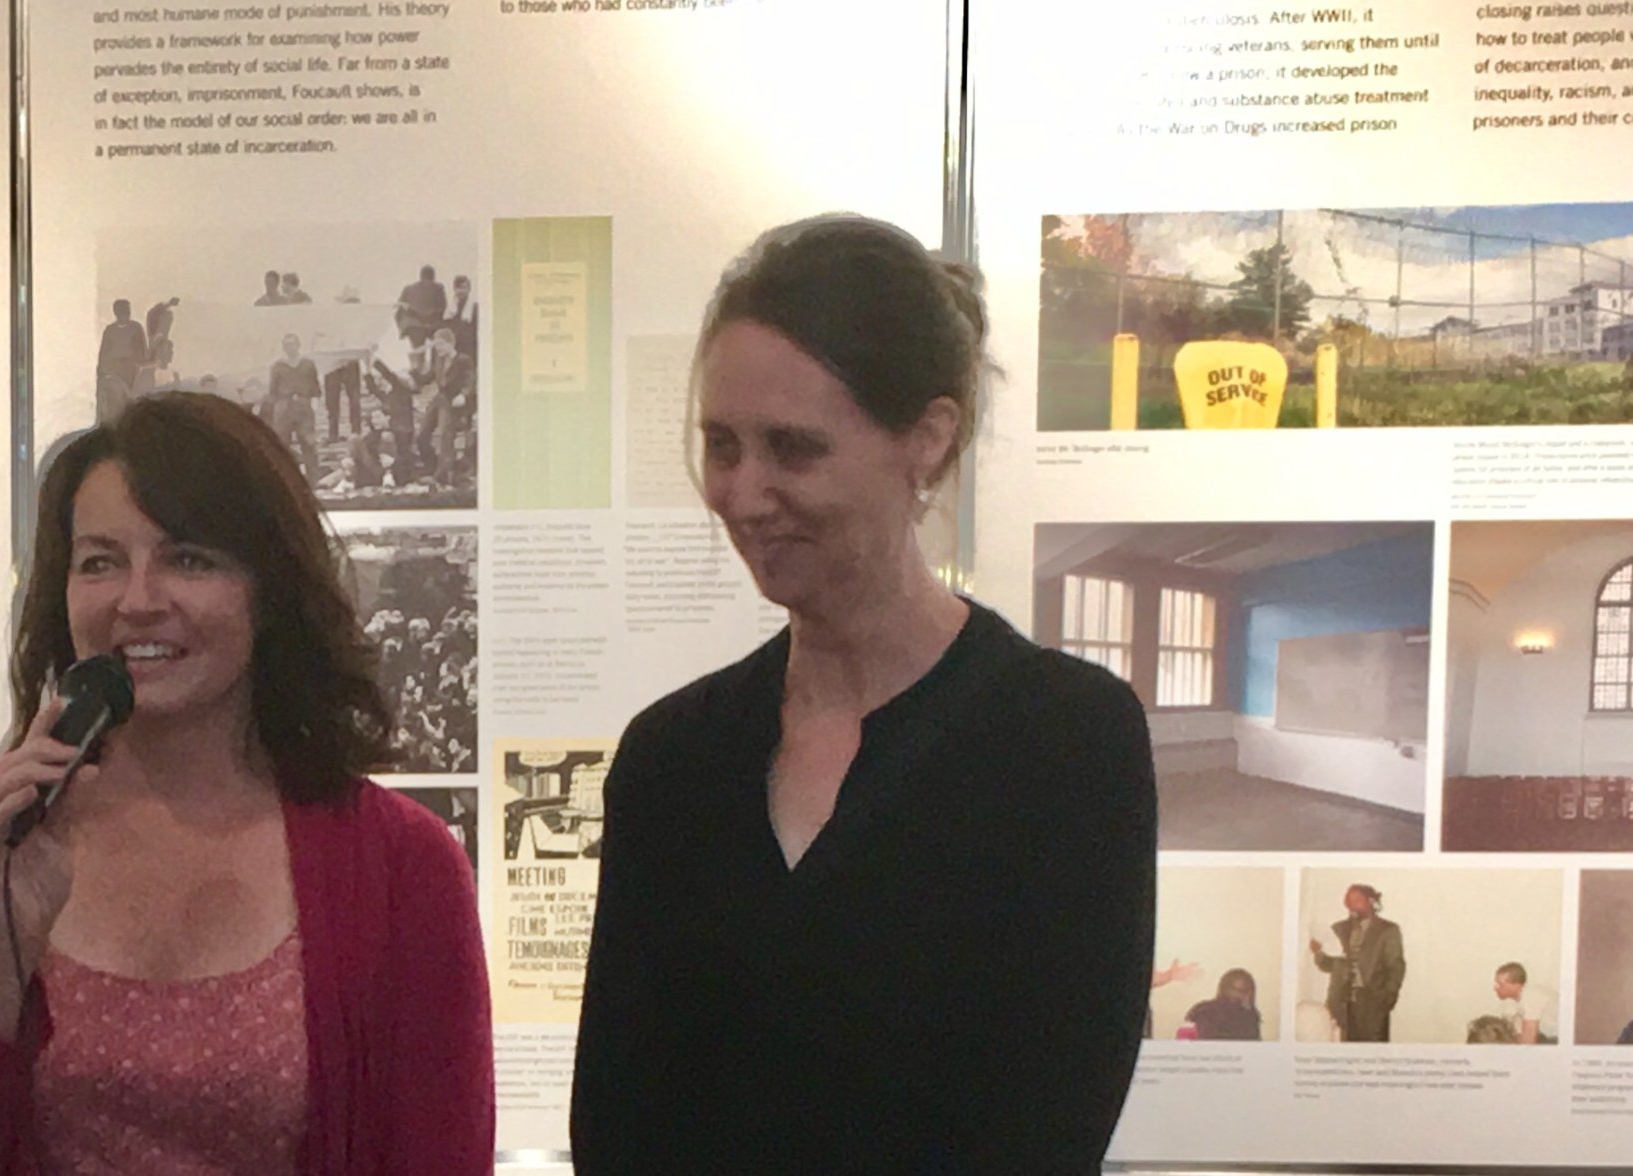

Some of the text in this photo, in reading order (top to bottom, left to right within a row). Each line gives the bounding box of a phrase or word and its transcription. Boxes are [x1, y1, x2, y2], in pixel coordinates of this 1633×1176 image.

[1476, 3, 1581, 22] closing raises
[1476, 29, 1625, 47] how to treat people
[1474, 58, 1490, 74] of
[1474, 85, 1553, 103] inequality,
[1473, 110, 1619, 131] prisoners and their
[1208, 366, 1267, 386] OUT OF
[507, 866, 566, 886] MEETING
[508, 917, 547, 936] FILMS
